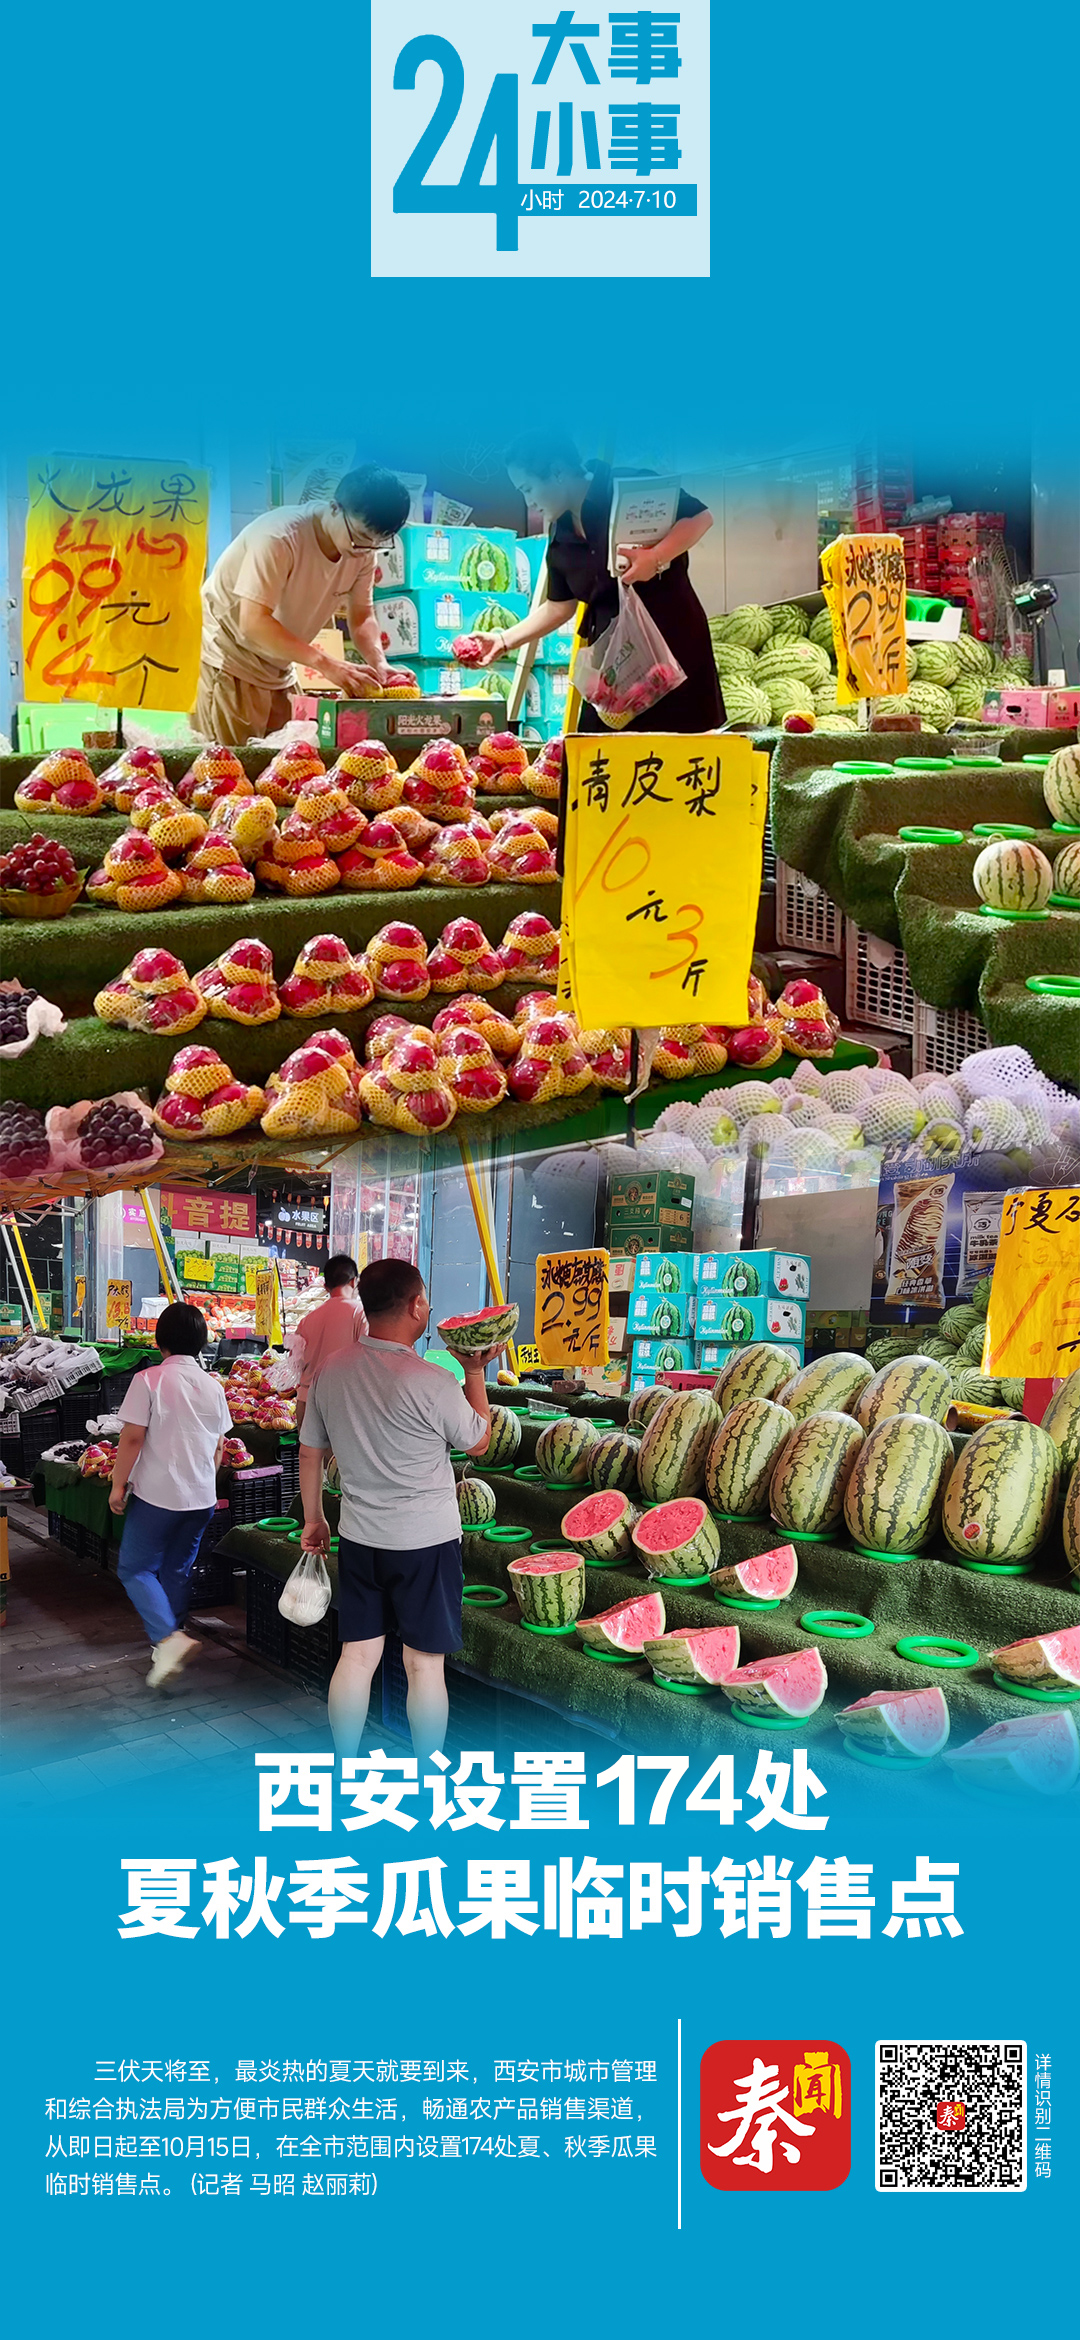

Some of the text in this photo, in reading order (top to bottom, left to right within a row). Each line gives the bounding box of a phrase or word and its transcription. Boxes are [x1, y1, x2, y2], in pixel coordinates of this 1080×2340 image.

[32, 464, 204, 524] 火龙果
[54, 514, 188, 570] 红心
[581, 748, 722, 818] 青皮梨
[291, 1210, 320, 1223] 水果区
[541, 1286, 602, 1335] 2.99
